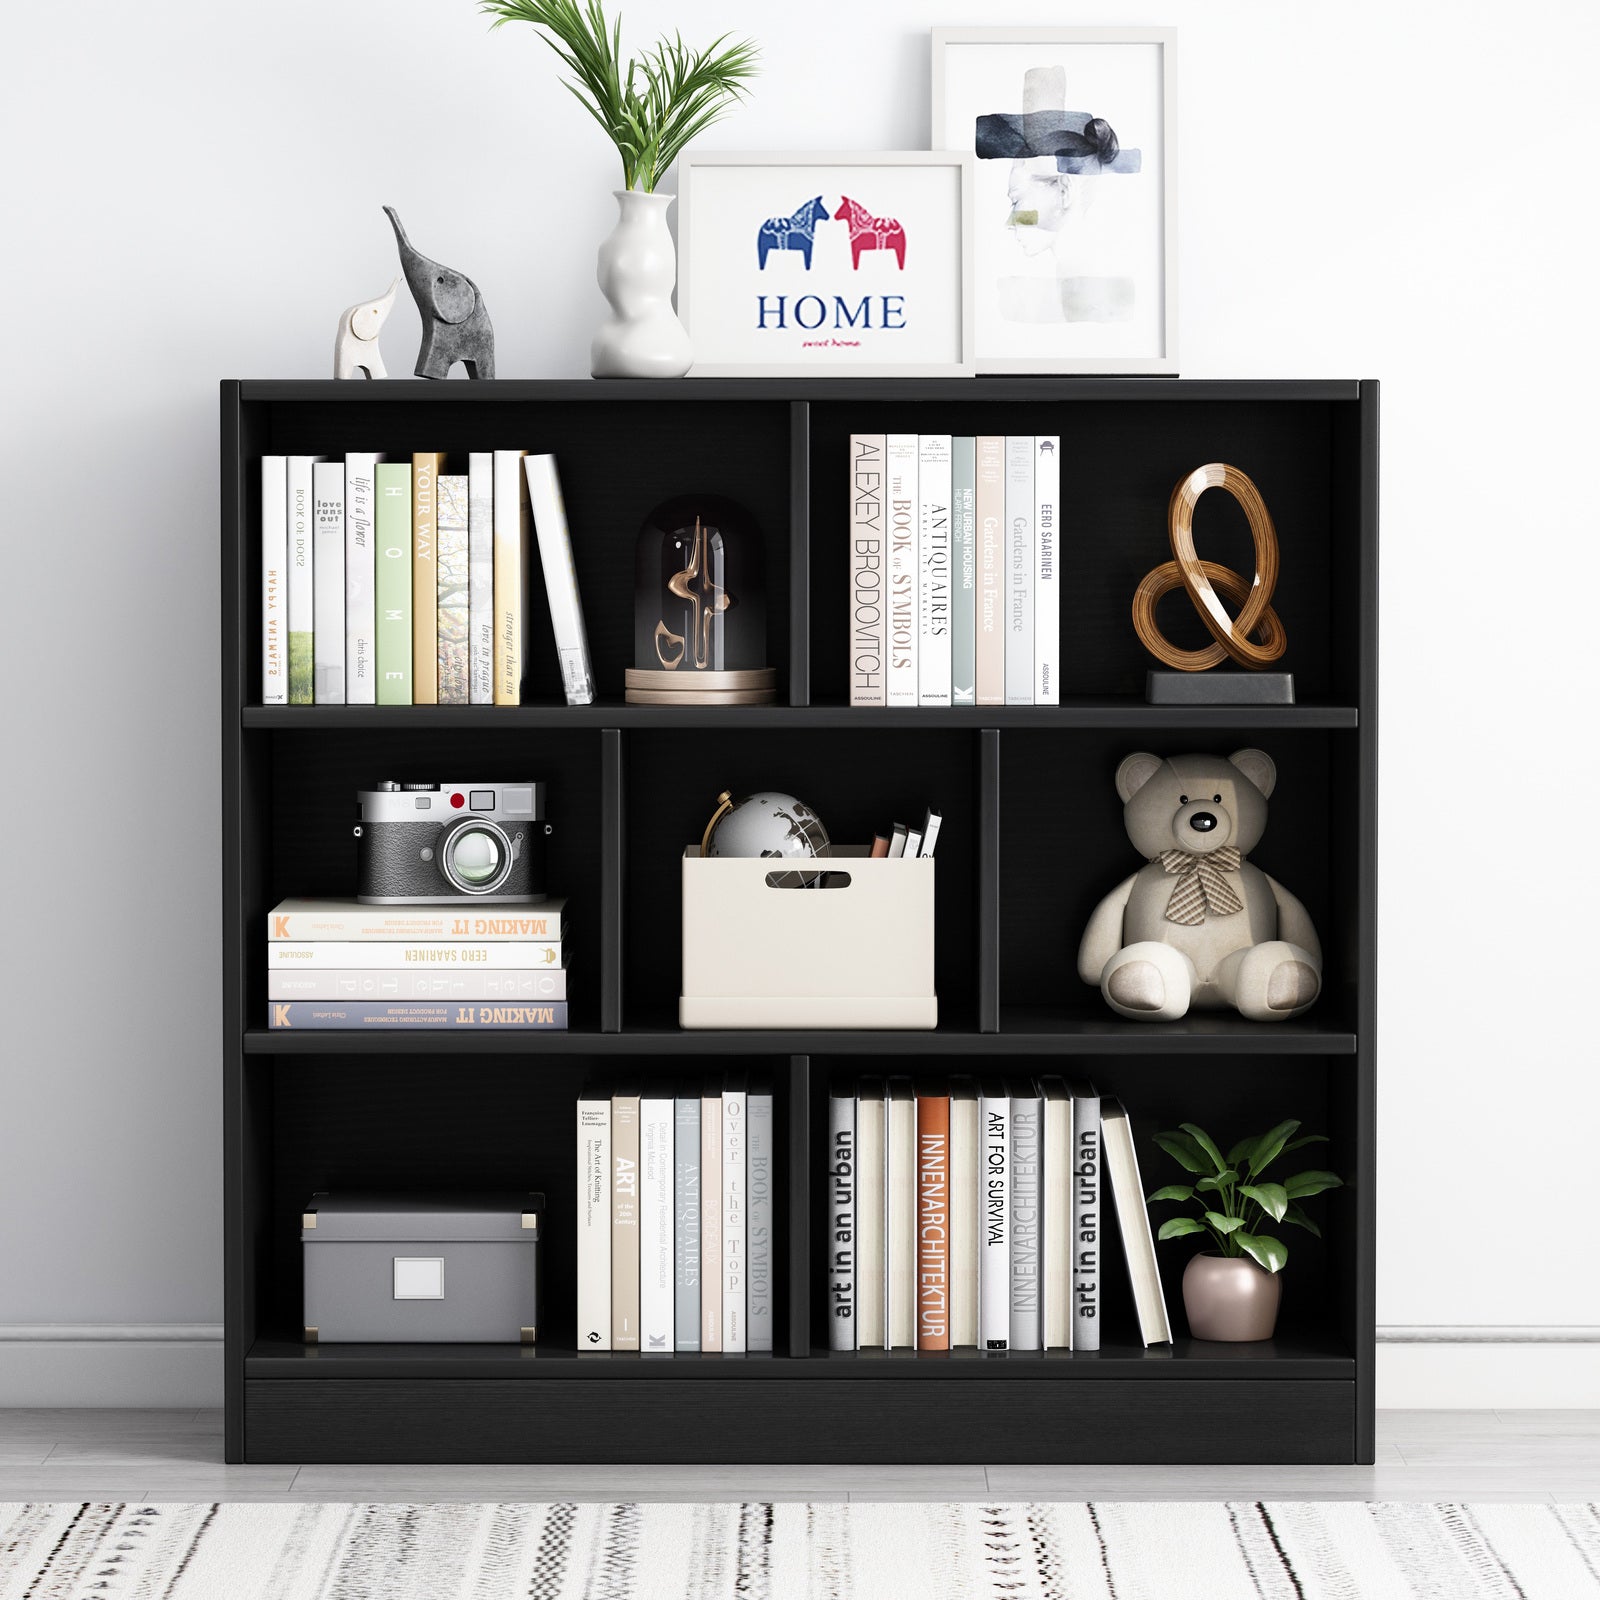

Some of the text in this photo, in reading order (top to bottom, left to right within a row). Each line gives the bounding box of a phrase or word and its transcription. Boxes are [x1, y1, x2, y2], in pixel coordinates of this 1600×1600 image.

[756, 295, 907, 329] HOME
[350, 477, 370, 493] life
[355, 496, 368, 504] is
[417, 464, 430, 561] YOUR WAY
[892, 477, 902, 495] THE
[350, 517, 370, 547] flower
[892, 499, 912, 553] BOOK
[954, 514, 962, 542] FRENCH
[963, 488, 972, 589] NEW URBAN HOUSING
[1041, 504, 1052, 580] EERO SAARINEN
[385, 487, 403, 680] HOME
[855, 441, 880, 688] ALEXEY BRODOVITCH
[928, 503, 947, 636] ANTIQUAIRES
[984, 516, 998, 633] Gardens in France
[1013, 516, 1027, 632] Gardens in France
[502, 612, 514, 695] stronger than sin
[892, 575, 912, 669] SYMBOLS
[357, 638, 369, 678] chris choice
[479, 624, 493, 693] love in prague
[279, 951, 314, 959] ASSOULINE
[405, 949, 488, 962] EERO SAARINEN
[451, 919, 547, 935] MAKING IT
[340, 977, 556, 993] Over the Top
[456, 1007, 554, 1024] MAKING IT
[593, 1139, 602, 1203] The Art of Knitting
[616, 1157, 635, 1196] ART
[647, 1151, 656, 1180] McLeod
[727, 1102, 740, 1290] Over the Top
[751, 1156, 768, 1207] BOOK
[988, 1112, 1004, 1246] ART FOR SURVIVAL
[614, 1218, 636, 1226] Century
[682, 1163, 698, 1286] ANTIQUAIRES
[829, 1131, 852, 1318] art in an urban
[921, 1134, 945, 1337] INNENARCHITEKTUR
[1013, 1112, 1036, 1313] INNENARCHITEKTUR
[1074, 1131, 1096, 1318] art in an urban
[751, 1227, 768, 1316] SYMBOLS
